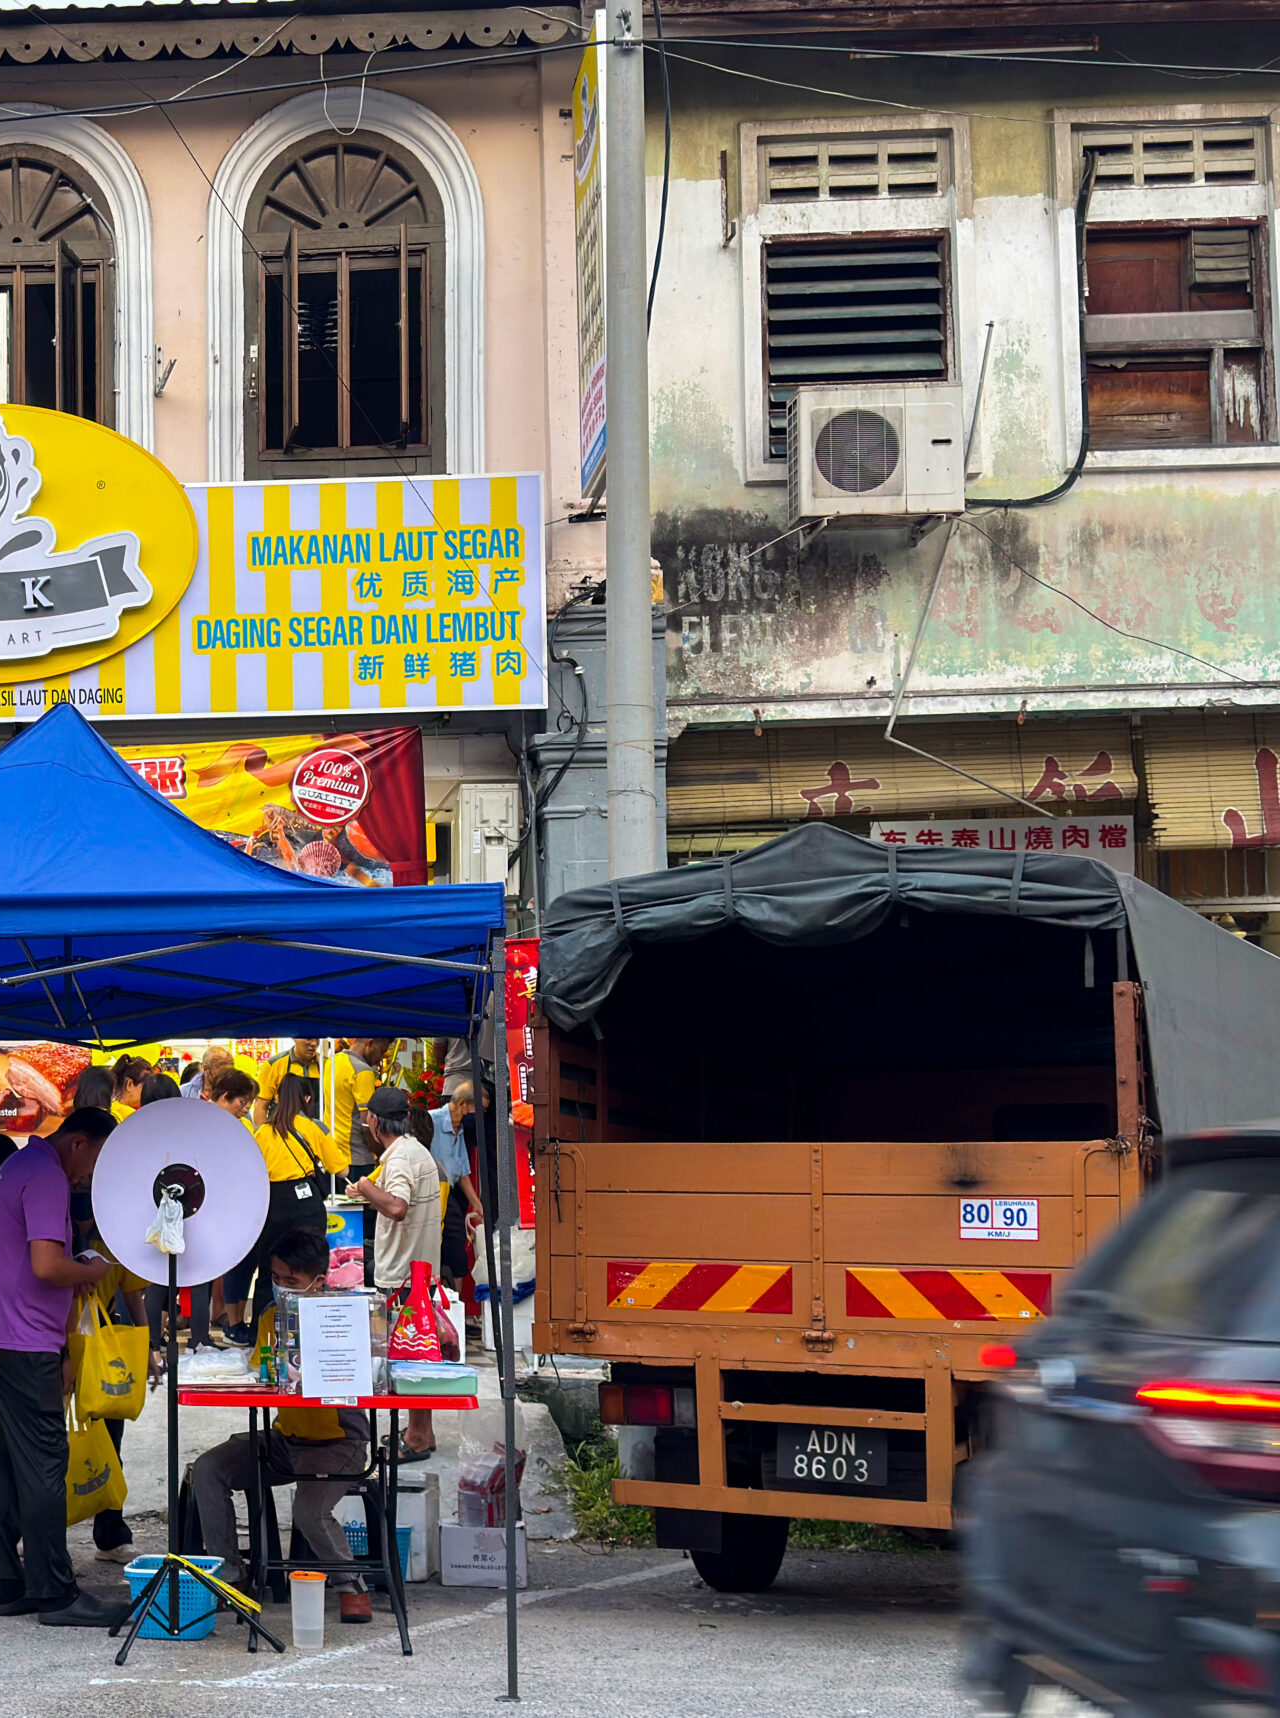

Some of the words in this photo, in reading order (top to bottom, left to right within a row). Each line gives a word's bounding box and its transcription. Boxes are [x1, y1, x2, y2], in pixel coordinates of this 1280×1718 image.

[252, 533, 371, 567] MAKANAN
[379, 530, 438, 562] LAUT
[444, 528, 520, 560] SEGAR
[356, 567, 520, 599] 优质海产
[197, 617, 281, 650] DAGING
[288, 615, 363, 648] SEGAR
[371, 613, 417, 645] DAN
[426, 611, 521, 643] LEMBUT
[358, 650, 522, 681] 新鲜猪肉
[19, 688, 48, 706] LAUT
[51, 688, 75, 705] DAN
[79, 688, 123, 705] DAGING
[318, 760, 352, 778] 100%
[303, 771, 359, 795] Premium
[298, 788, 356, 808] QUALITY
[962, 1203, 990, 1224] 80
[1003, 1208, 1028, 1227] 90
[806, 1429, 855, 1456] ADN
[794, 1454, 868, 1482] 8603
